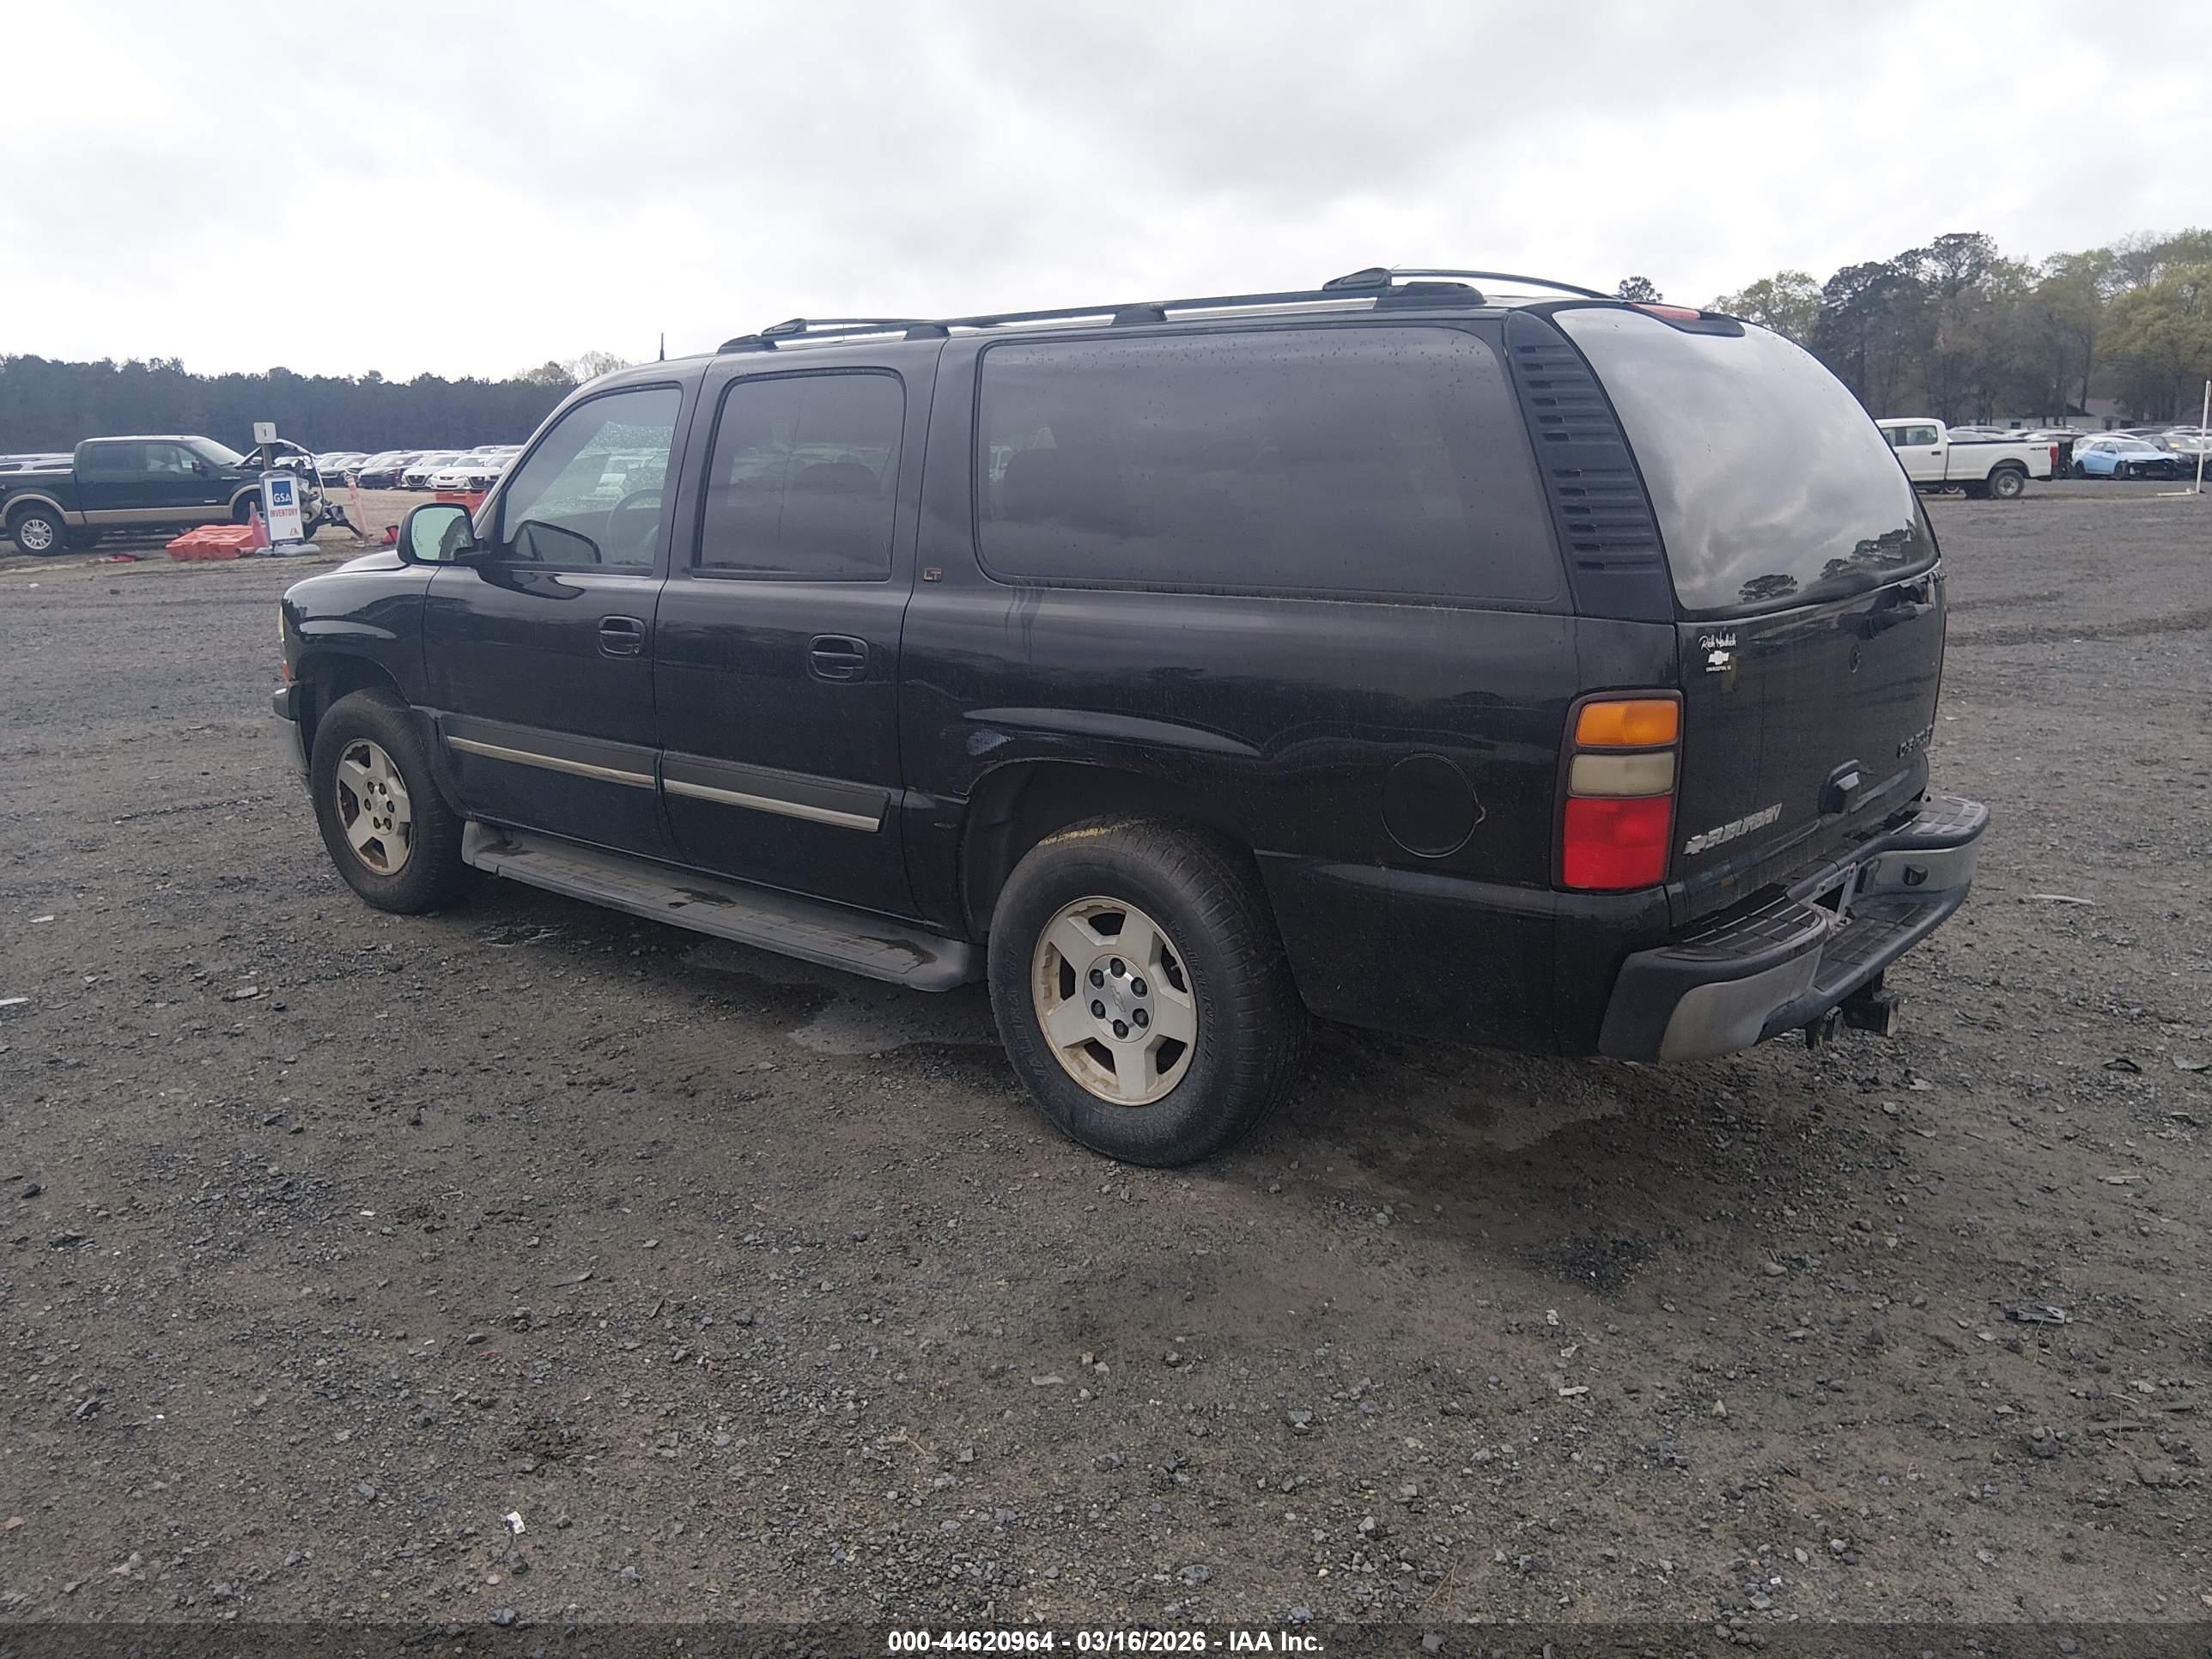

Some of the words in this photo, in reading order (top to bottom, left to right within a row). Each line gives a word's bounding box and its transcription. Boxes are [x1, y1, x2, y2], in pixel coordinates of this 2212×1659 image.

[274, 493, 291, 502] GSA
[270, 508, 298, 517] INVENTORY
[1705, 802, 1783, 849] SUBURBAN
